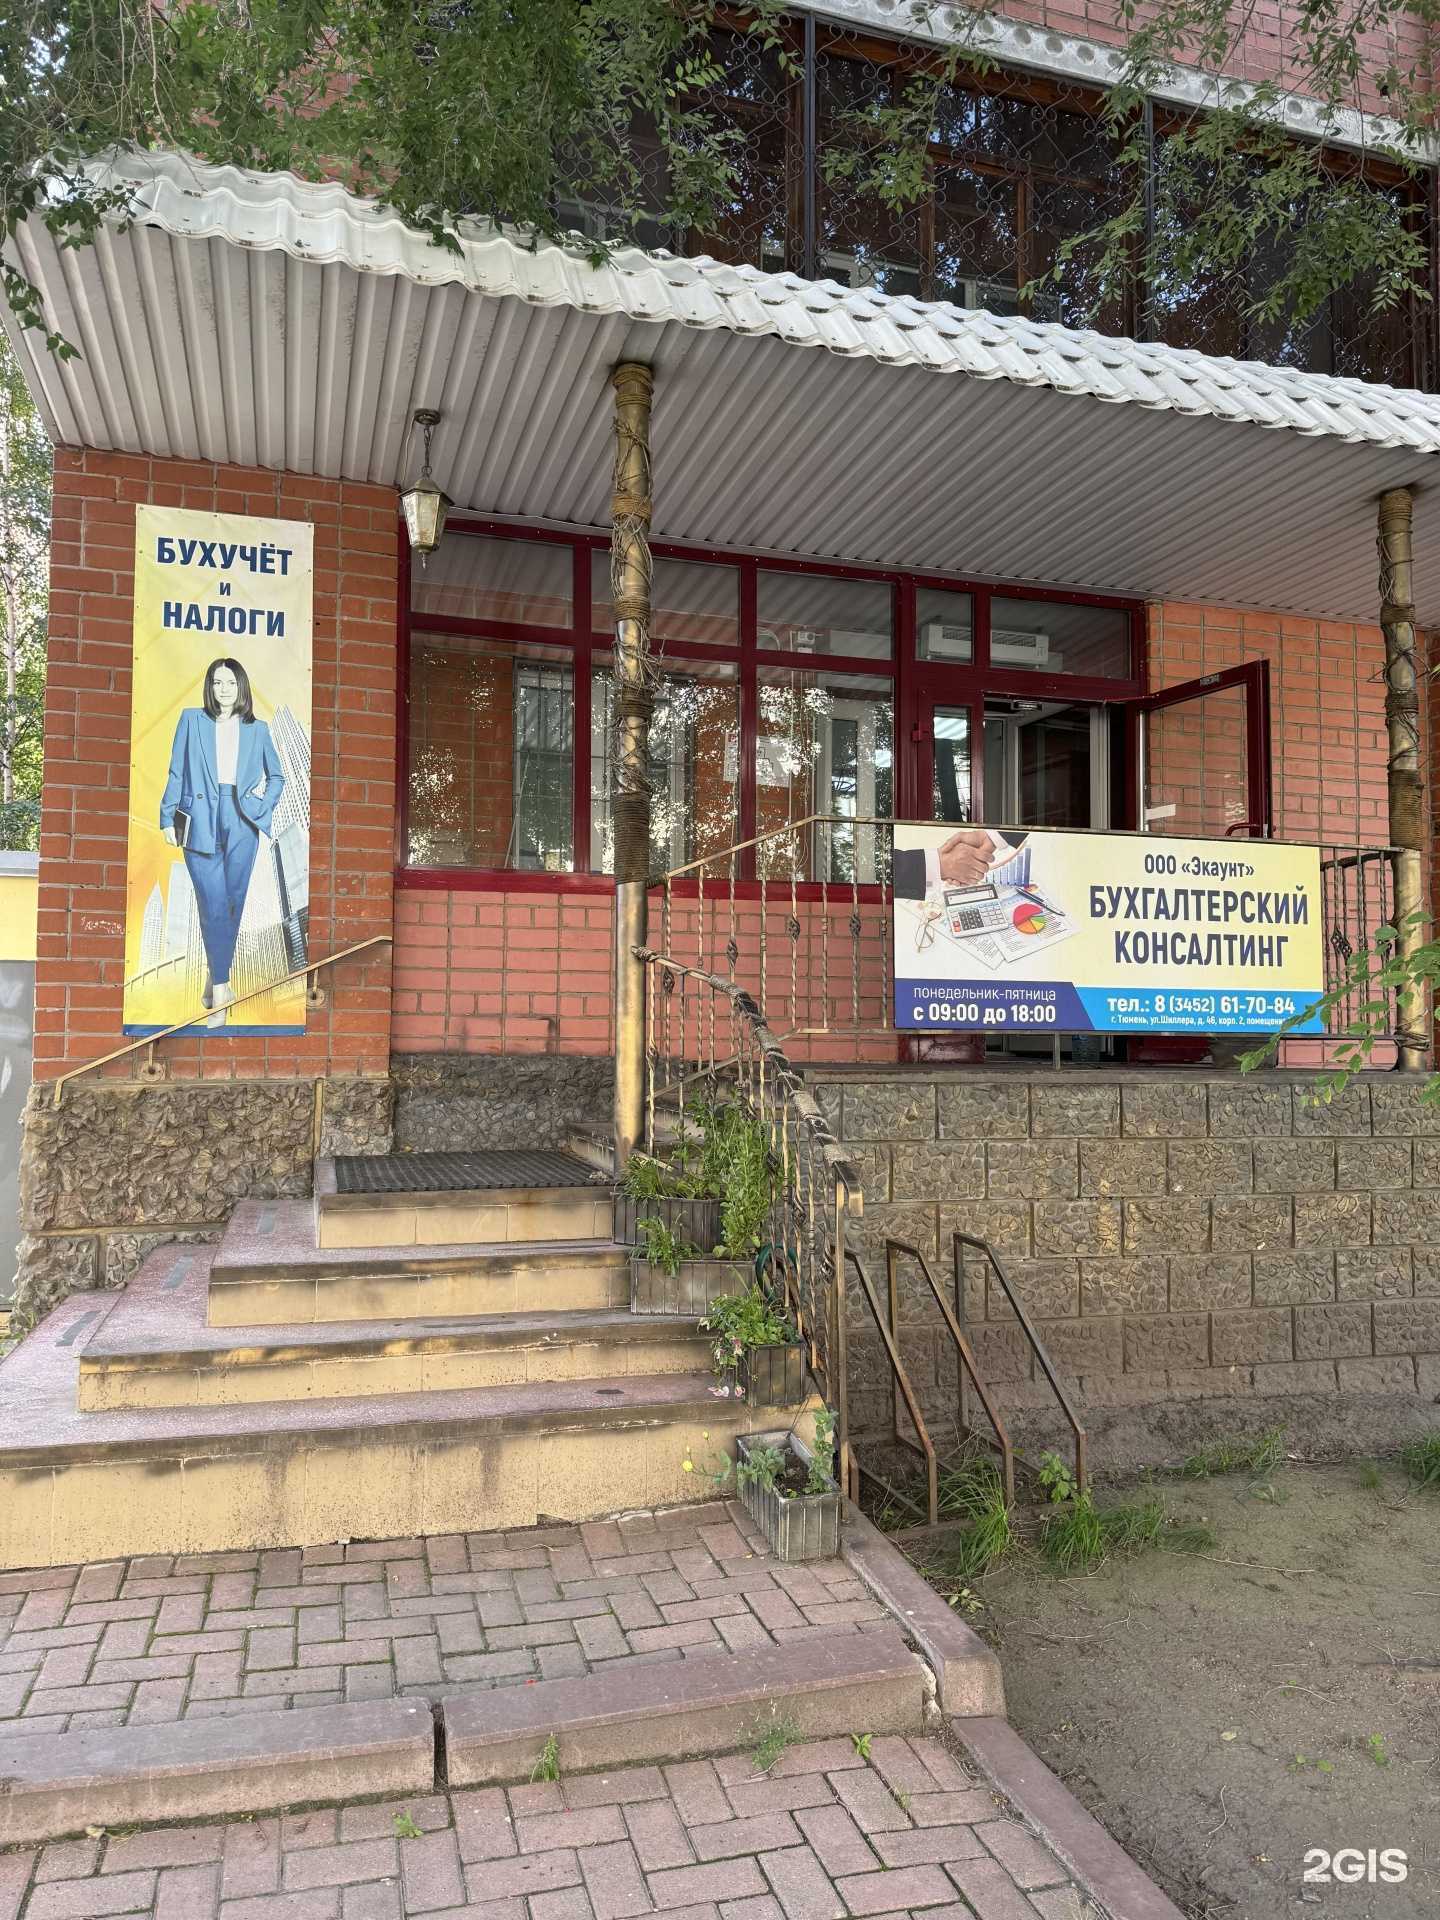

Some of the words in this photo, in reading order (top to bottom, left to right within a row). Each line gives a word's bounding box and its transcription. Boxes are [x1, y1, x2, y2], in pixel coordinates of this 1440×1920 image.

[157, 537, 292, 575] БУХУЧЁТ
[219, 582, 230, 596] и
[163, 601, 285, 637] НАЛОГИ
[1144, 854, 1177, 875] ООО
[1181, 856, 1255, 881] «Экаунт»
[1089, 885, 1308, 925] БУХГАЛТЕРСКИЙ
[1114, 930, 1289, 967] КОНСАЛТИНГ
[913, 987, 1056, 1002] понедельник-пятница
[1107, 996, 1150, 1013] тел.:
[1154, 994, 1165, 1013] 8
[1169, 995, 1215, 1015] (3452)
[1220, 996, 1295, 1014] 61-70-84
[913, 1006, 924, 1021] с
[928, 1003, 979, 1022] 09:00
[983, 1008, 1006, 1025] до
[1010, 1004, 1056, 1023] 18:00
[1118, 1015, 1148, 1025] Тюмень,
[1246, 1018, 1288, 1028] помещени
